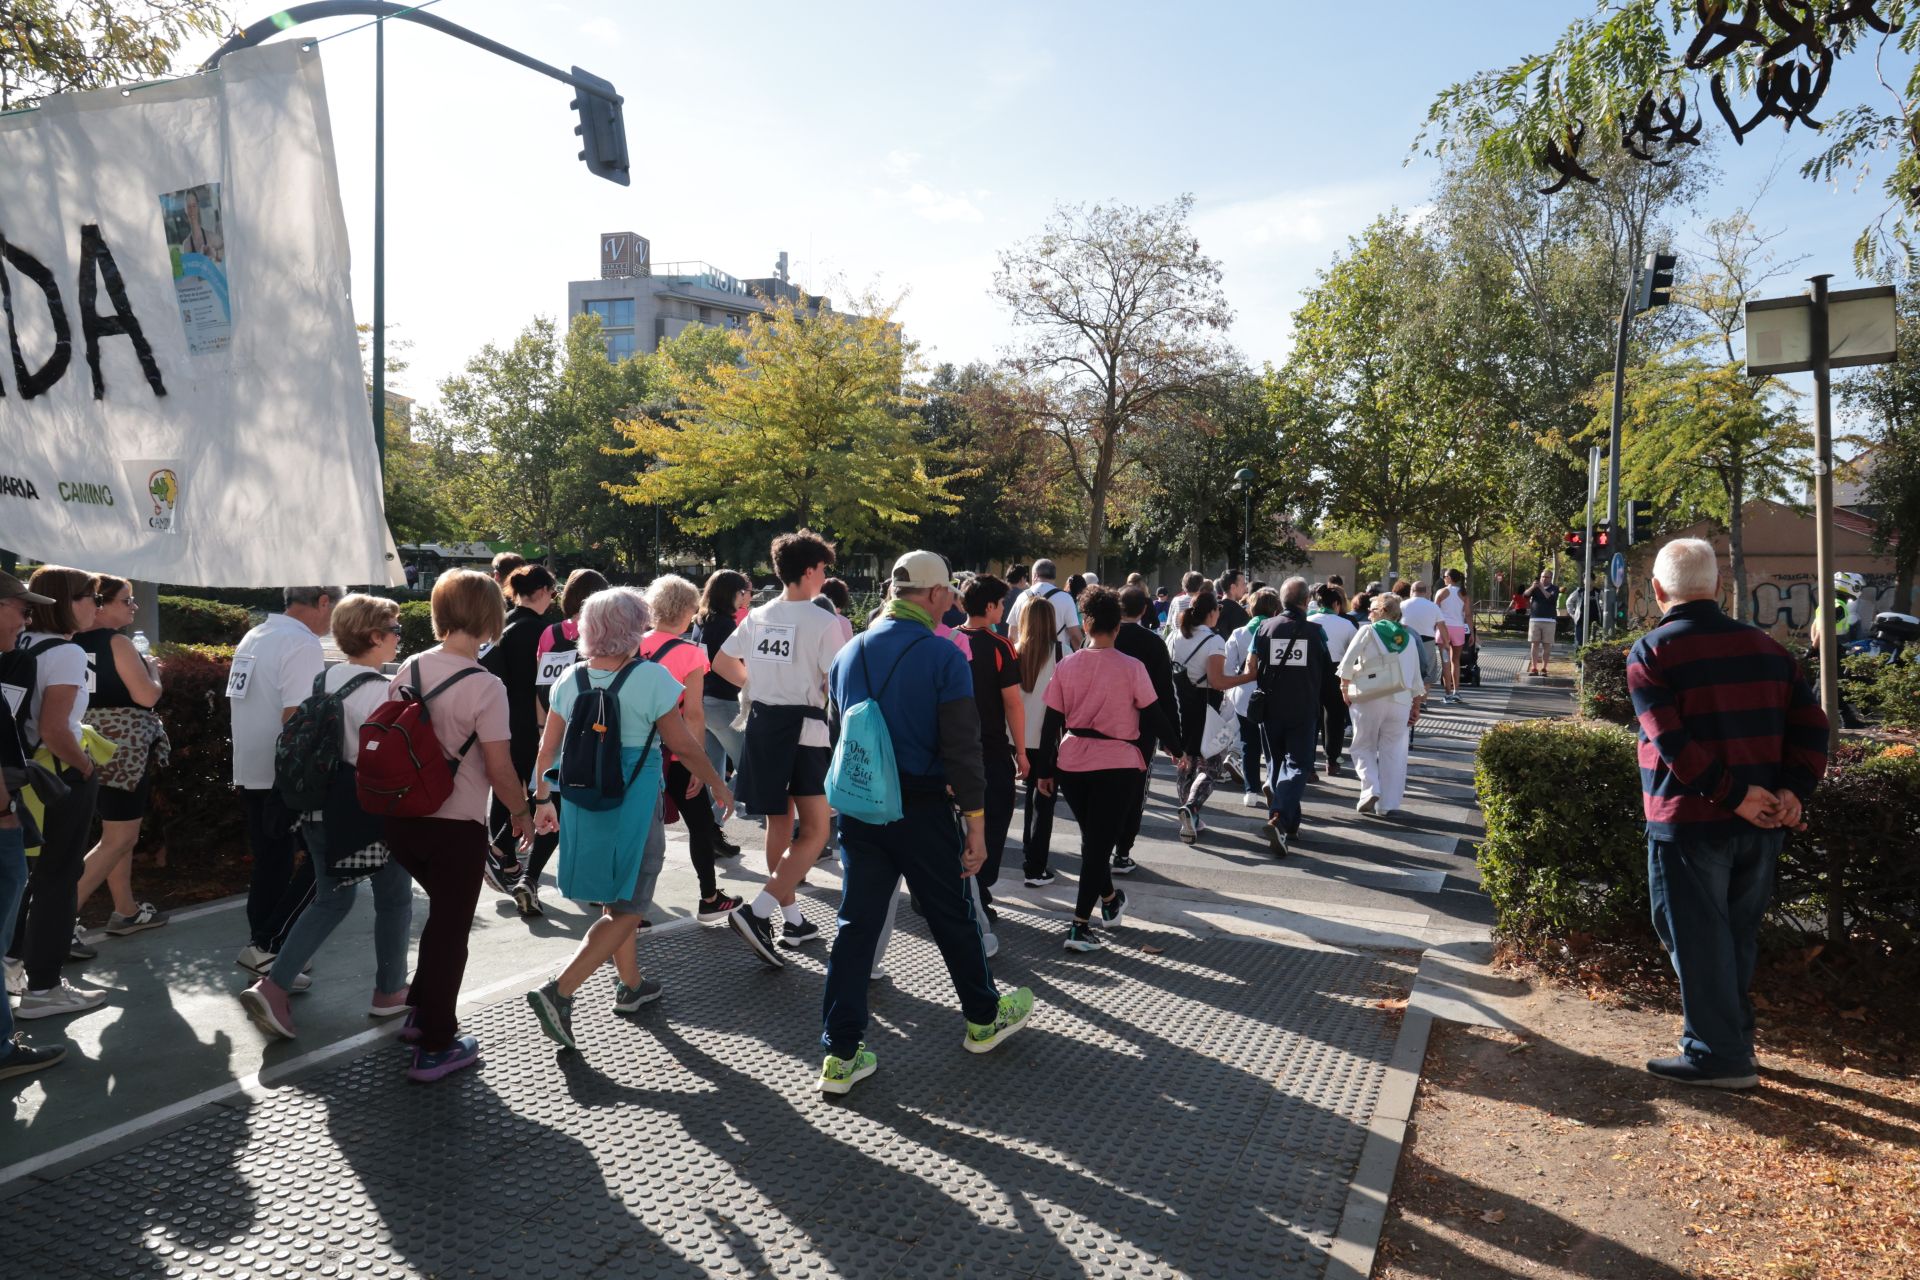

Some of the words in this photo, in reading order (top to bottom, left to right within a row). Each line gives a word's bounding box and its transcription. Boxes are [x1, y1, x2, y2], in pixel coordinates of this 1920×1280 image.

[604, 237, 625, 261] V
[0, 224, 168, 400] DA
[0, 475, 40, 500] ARIA
[58, 481, 115, 507] CAMINO
[757, 638, 790, 657] 443
[229, 672, 248, 691] 73
[852, 764, 873, 781] Bici
